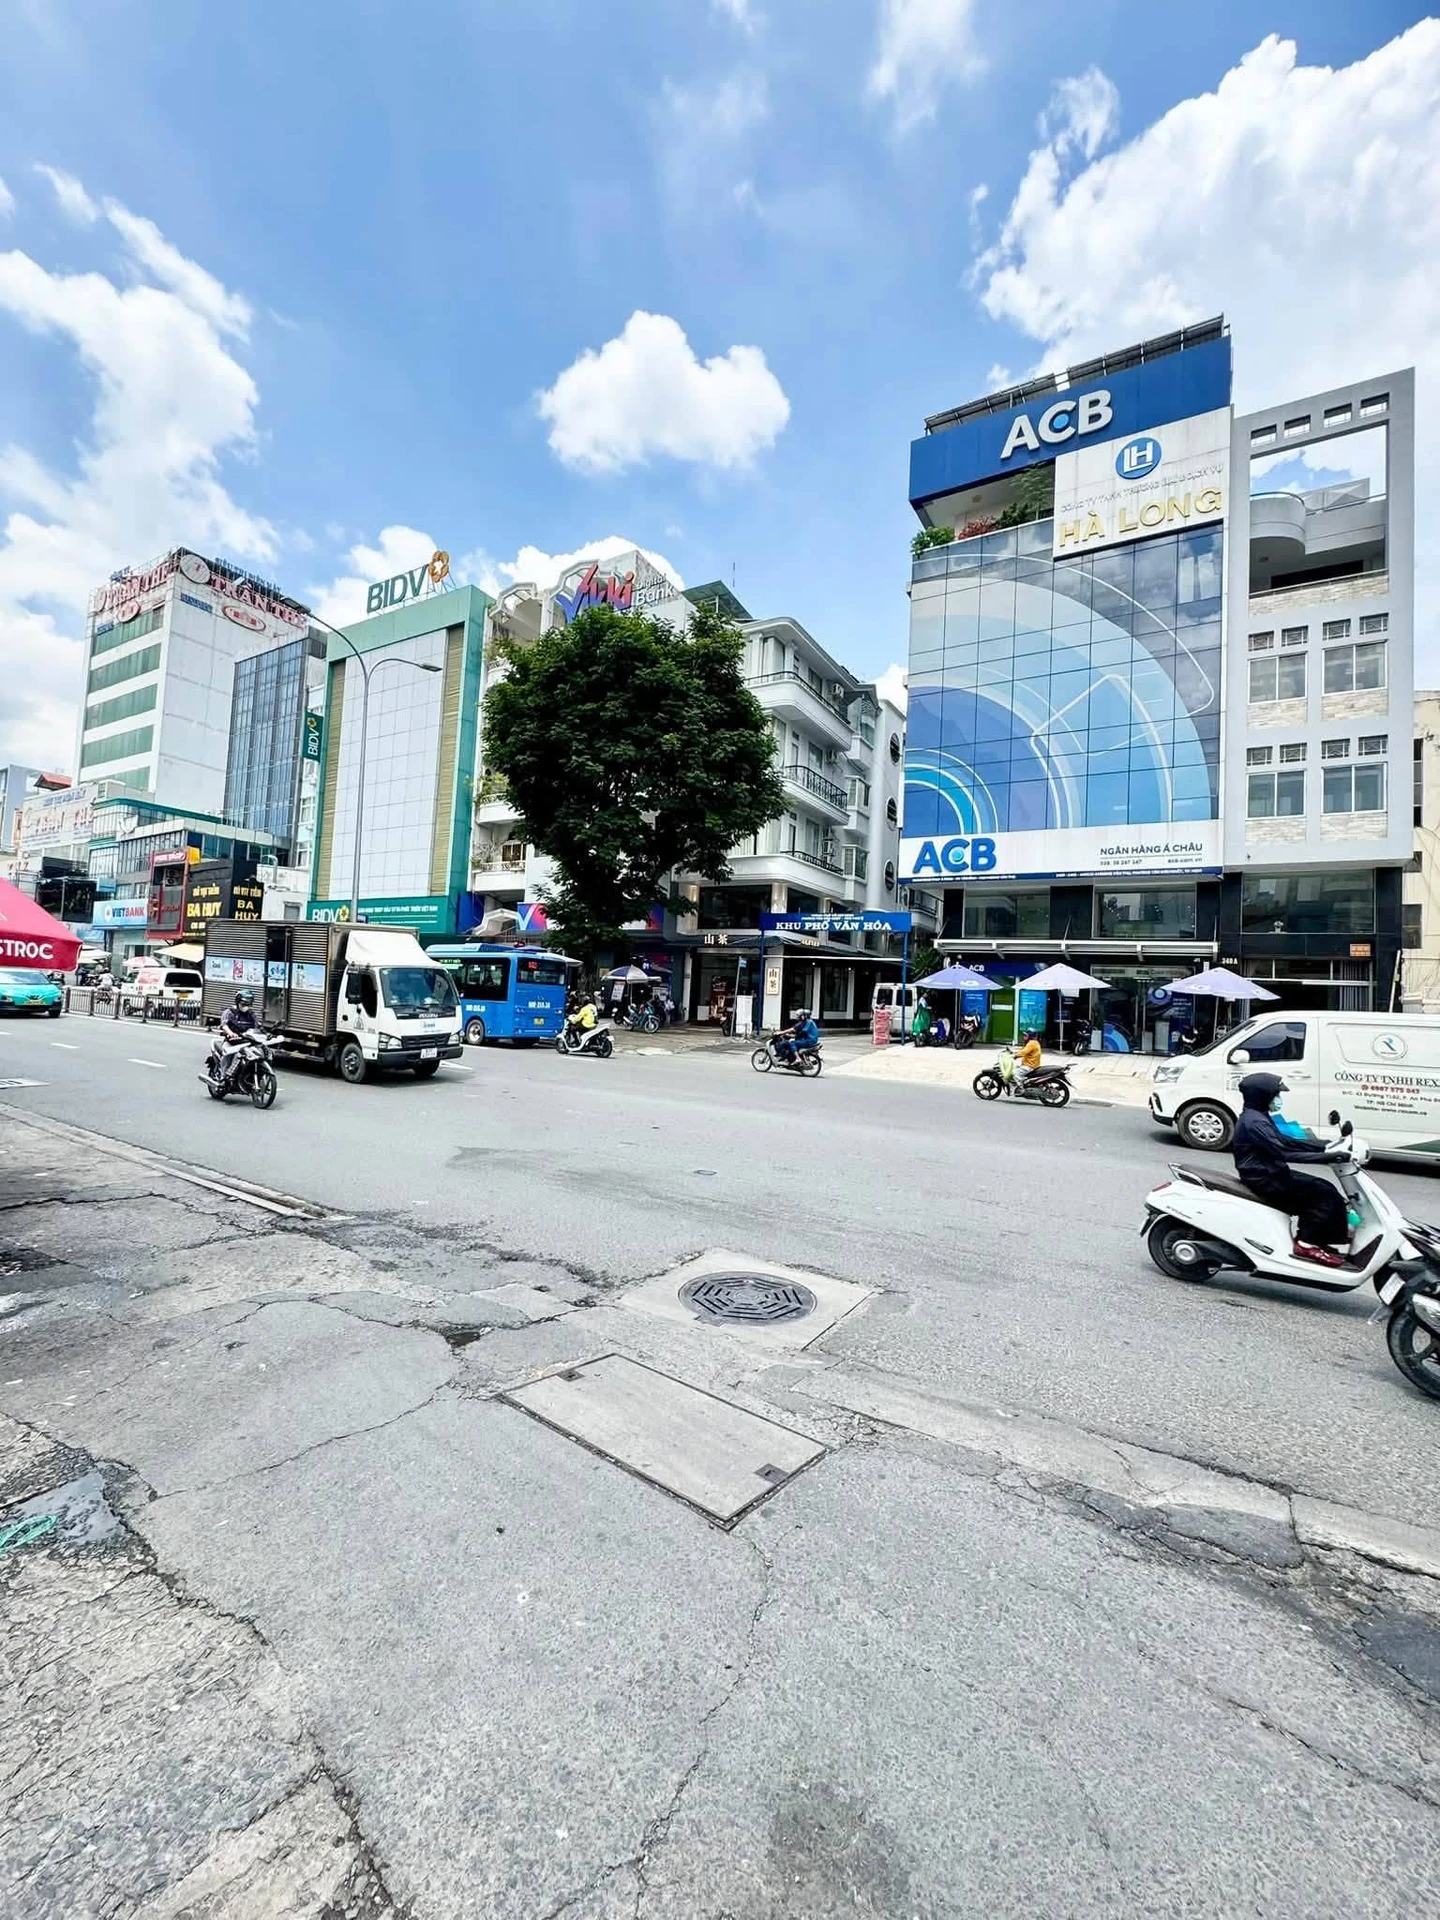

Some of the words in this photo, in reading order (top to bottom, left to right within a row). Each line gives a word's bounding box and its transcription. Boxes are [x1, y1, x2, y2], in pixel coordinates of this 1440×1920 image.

[1000, 389, 1113, 460] ACB
[1059, 511, 1105, 548] HÀ
[1118, 486, 1223, 534] LONG
[366, 564, 430, 614] BIDV
[636, 583, 674, 607] Bank
[307, 724, 320, 756] BIDV
[912, 837, 997, 875] ACB
[1100, 845, 1129, 856] NGÂN
[1131, 843, 1161, 855] HÀNG
[1163, 841, 1171, 853] Á
[1173, 840, 1203, 853] CHÂU
[112, 906, 145, 918] VIETBANK
[187, 903, 200, 917] BA
[202, 901, 222, 917] HUY
[237, 900, 254, 910] BA
[234, 910, 259, 920] HUY
[312, 908, 341, 922] BIDV
[776, 921, 801, 930] KHU
[805, 918, 830, 930] PHỐ
[833, 920, 860, 930] VĂN
[863, 919, 892, 930] HÓA
[969, 964, 985, 972] ACB
[1334, 1071, 1362, 1081] CÔNG
[1365, 1074, 1379, 1083] TY
